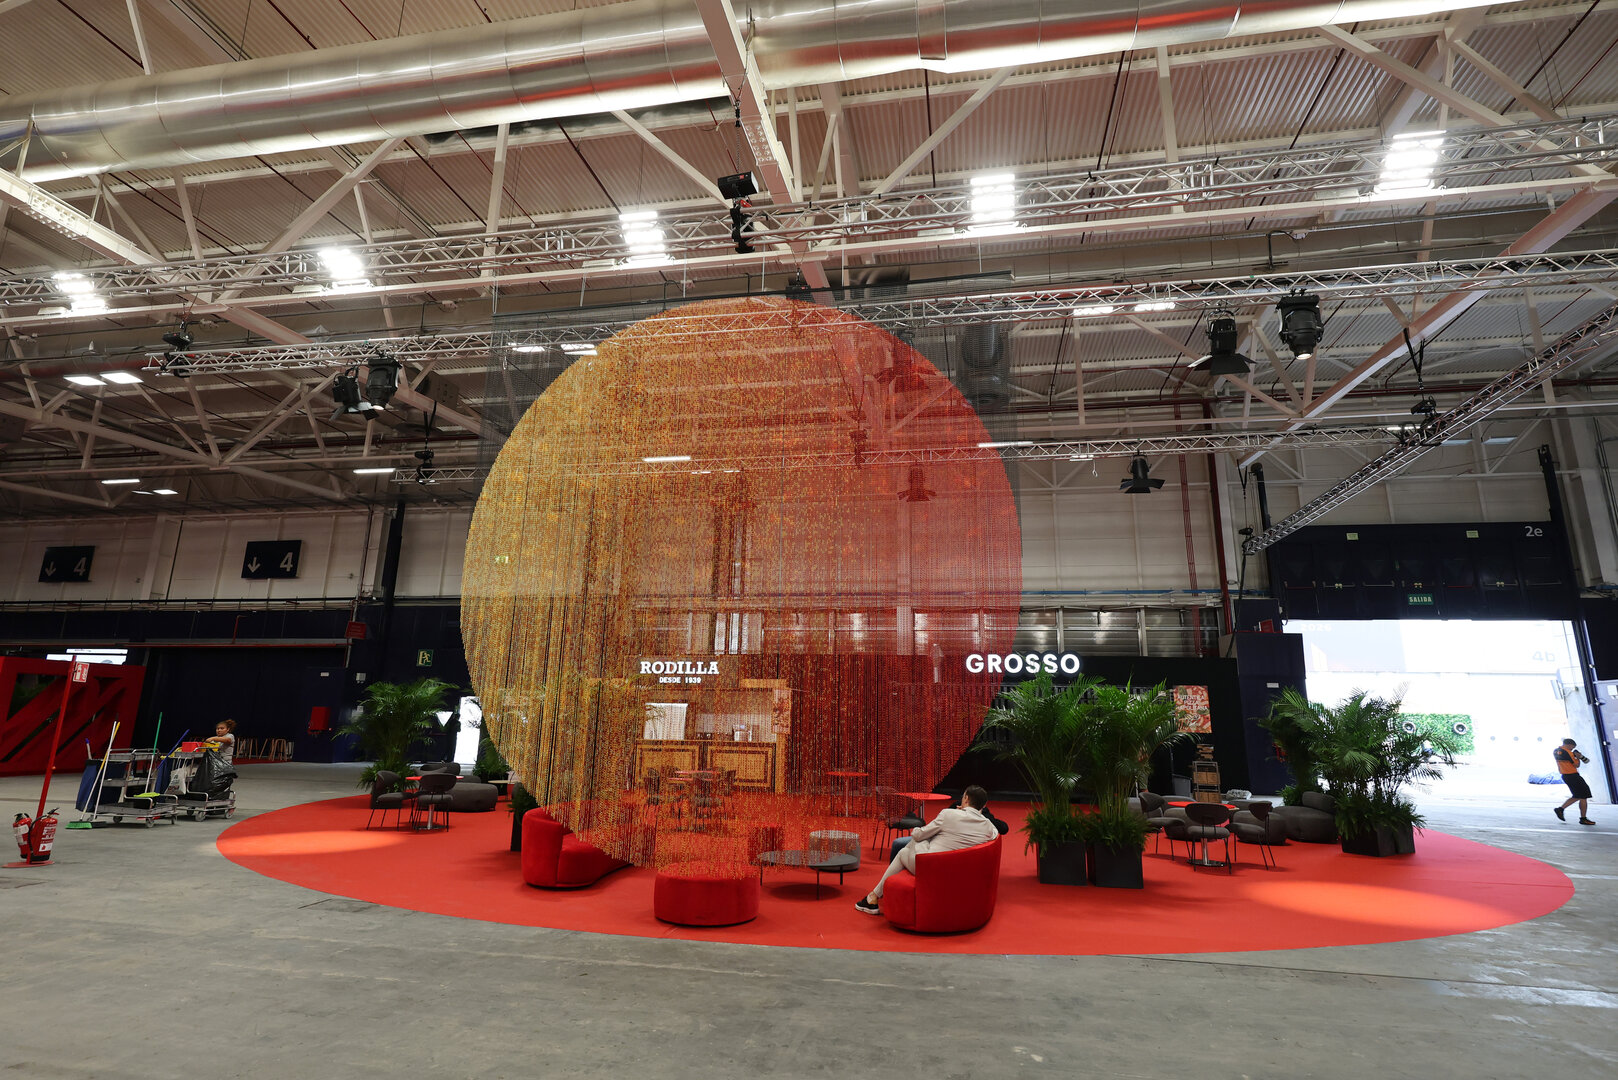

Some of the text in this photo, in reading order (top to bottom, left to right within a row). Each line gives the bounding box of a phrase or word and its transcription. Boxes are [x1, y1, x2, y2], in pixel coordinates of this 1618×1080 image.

[1525, 525, 1543, 537] 2e
[73, 557, 87, 576] 4
[280, 551, 294, 572] 4
[640, 661, 720, 675] RODILLA
[965, 653, 1081, 674] GROSSO
[659, 676, 681, 684] DESDE
